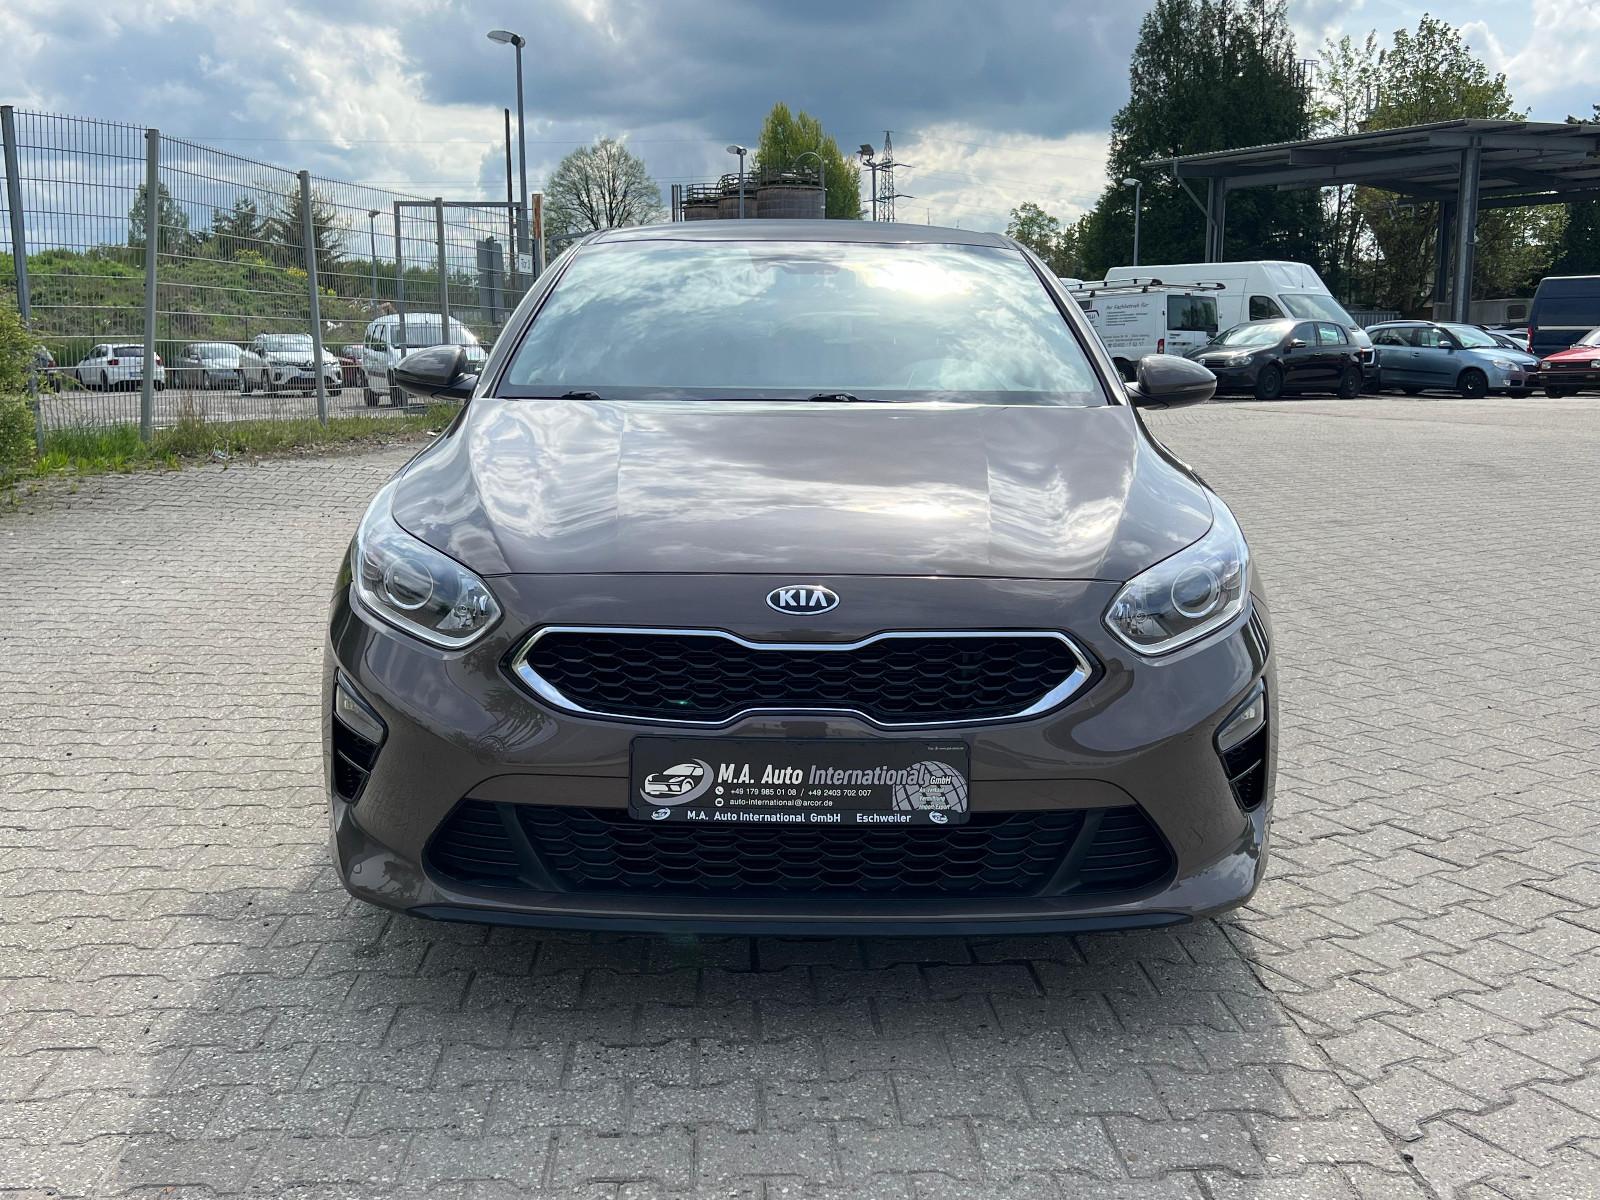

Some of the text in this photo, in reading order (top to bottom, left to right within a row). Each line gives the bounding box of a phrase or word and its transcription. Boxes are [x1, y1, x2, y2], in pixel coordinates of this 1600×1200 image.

[779, 589, 828, 607] KIA
[718, 763, 952, 785] M.A. Auto International GmbH
[808, 789, 821, 797] +49
[823, 789, 841, 797] 2403
[729, 799, 833, 807] auto-international@arcor.de
[687, 810, 912, 823] M.A. Auto International GmbH Eschweiler
